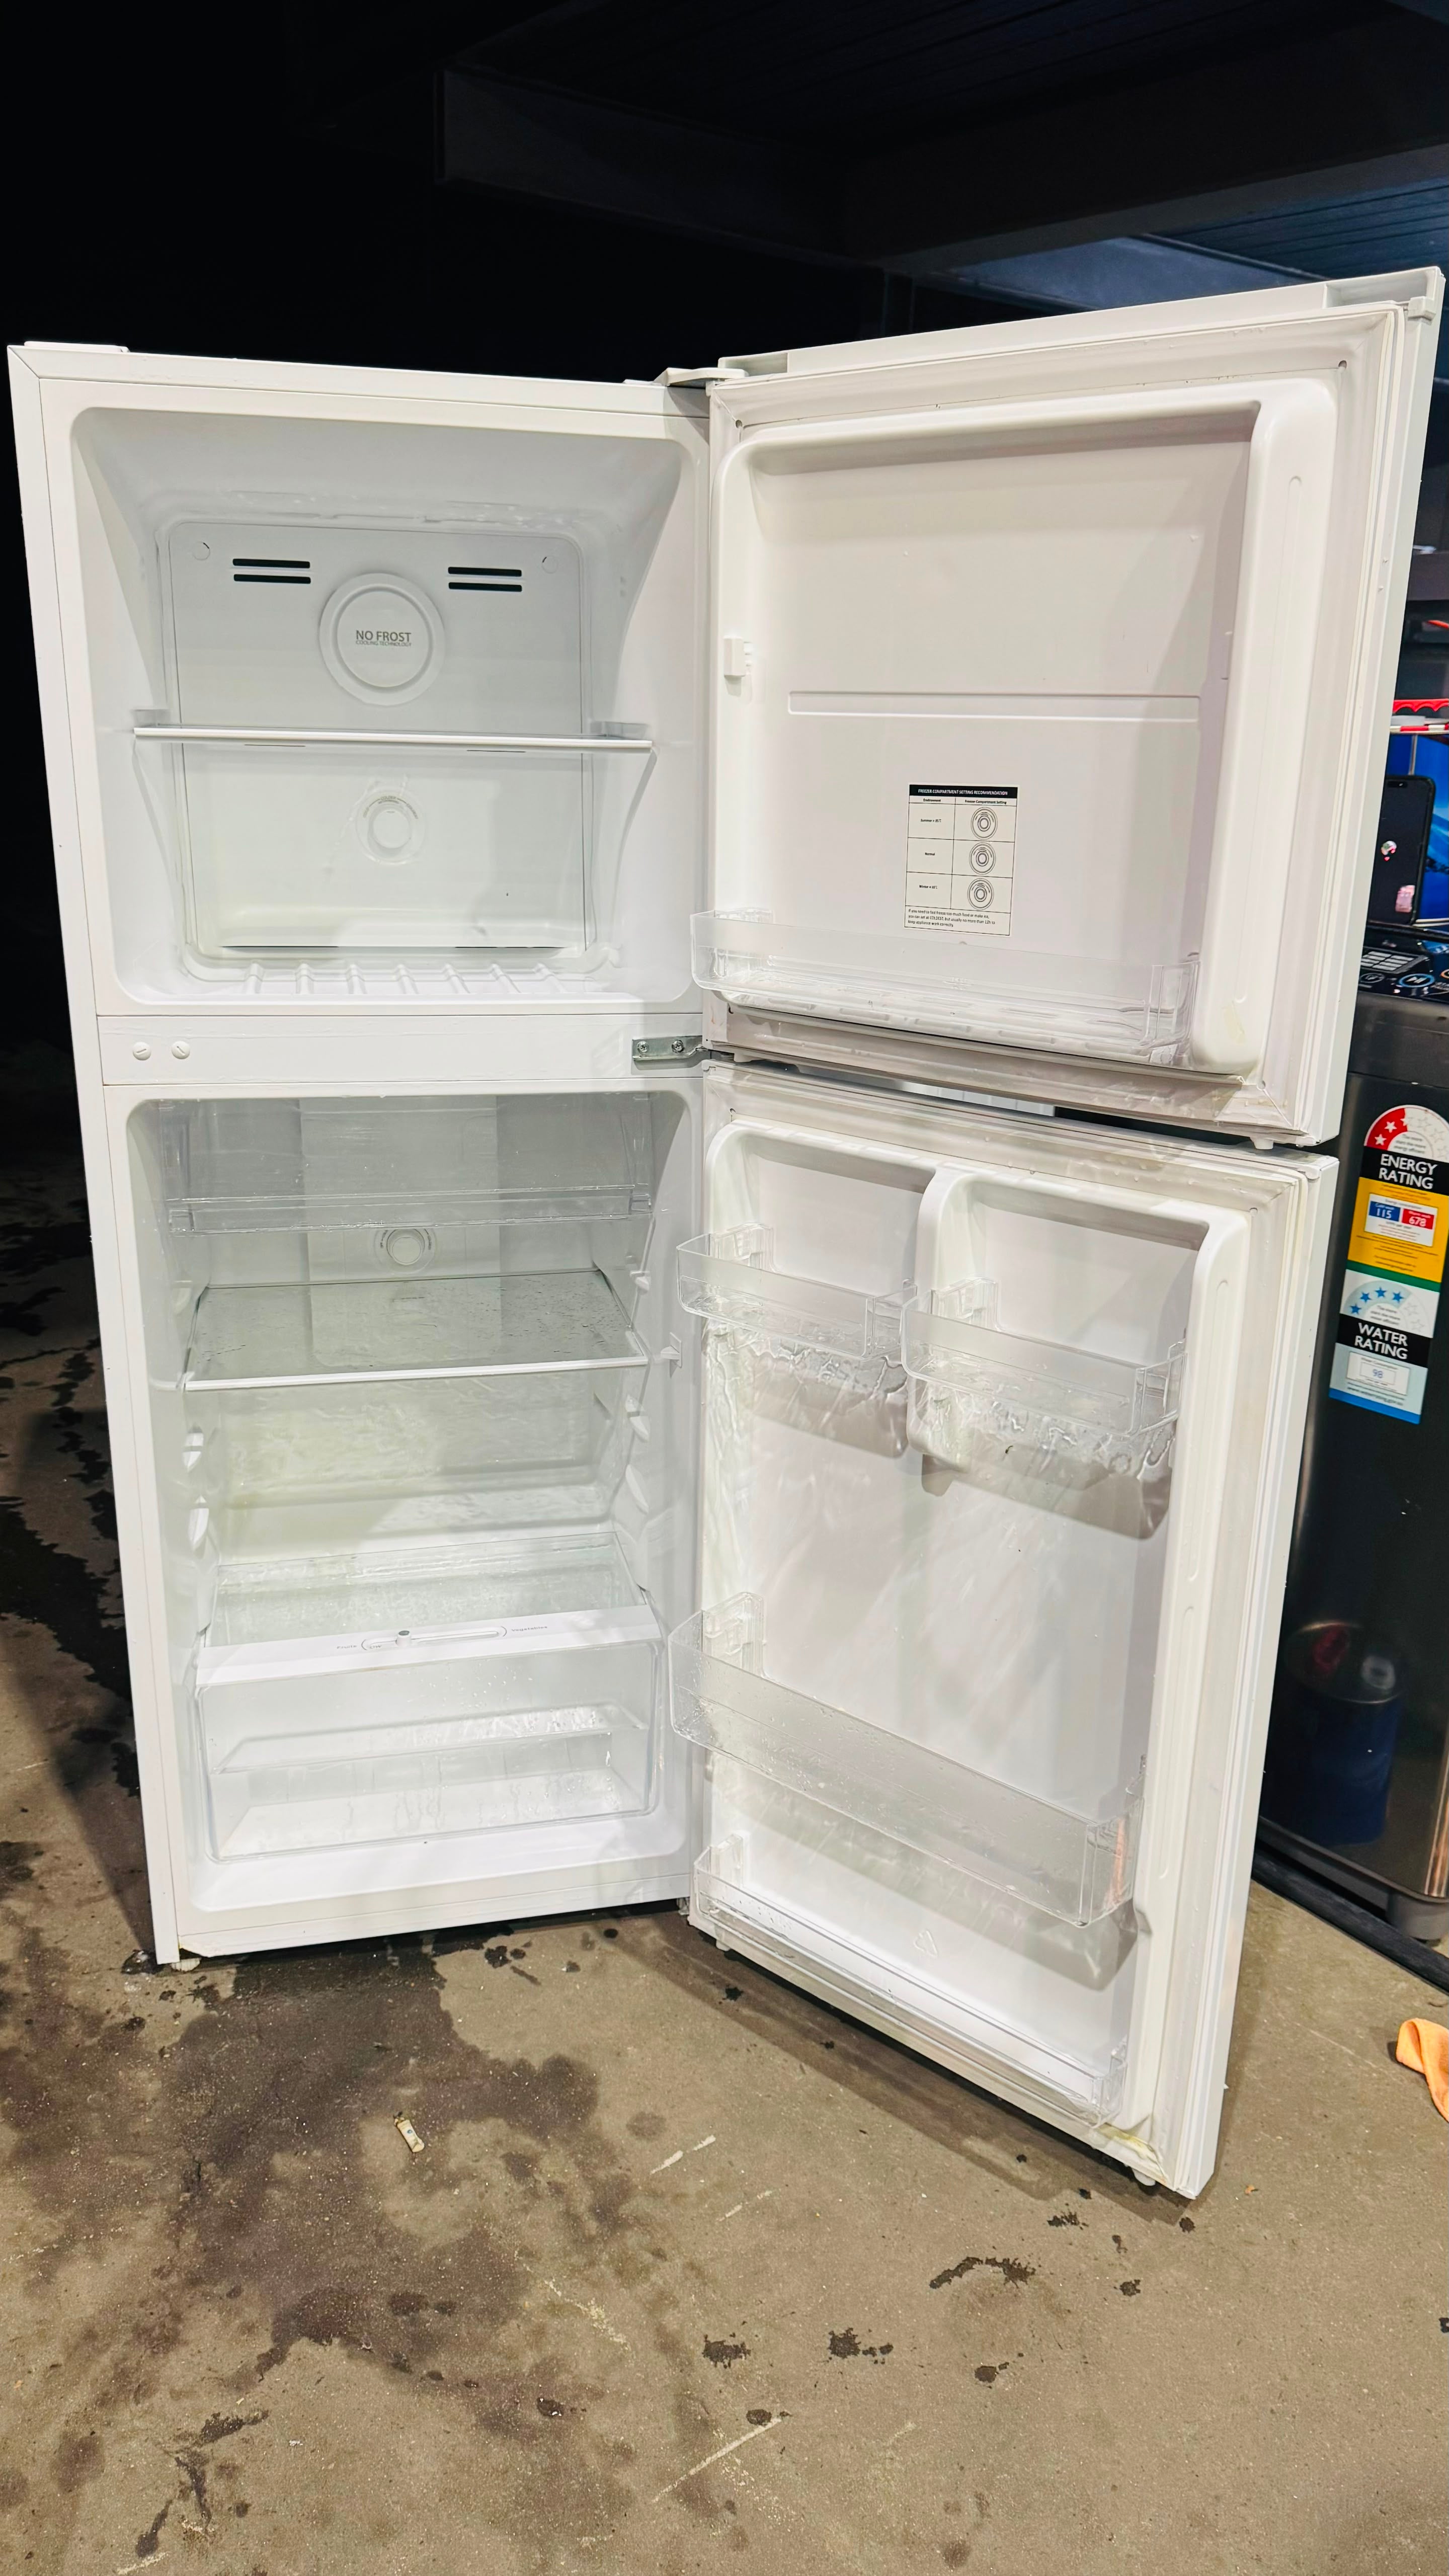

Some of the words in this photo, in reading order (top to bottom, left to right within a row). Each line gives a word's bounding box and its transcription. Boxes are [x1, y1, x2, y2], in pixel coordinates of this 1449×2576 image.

[356, 630, 373, 640] NO
[376, 631, 412, 642] FROST
[1381, 1154, 1438, 1175] ENERGY
[1379, 1168, 1434, 1189] RATING
[1377, 1208, 1392, 1219] 115
[1409, 1216, 1426, 1227] 678
[1358, 1323, 1408, 1346] WATER
[1354, 1335, 1408, 1359] RATING
